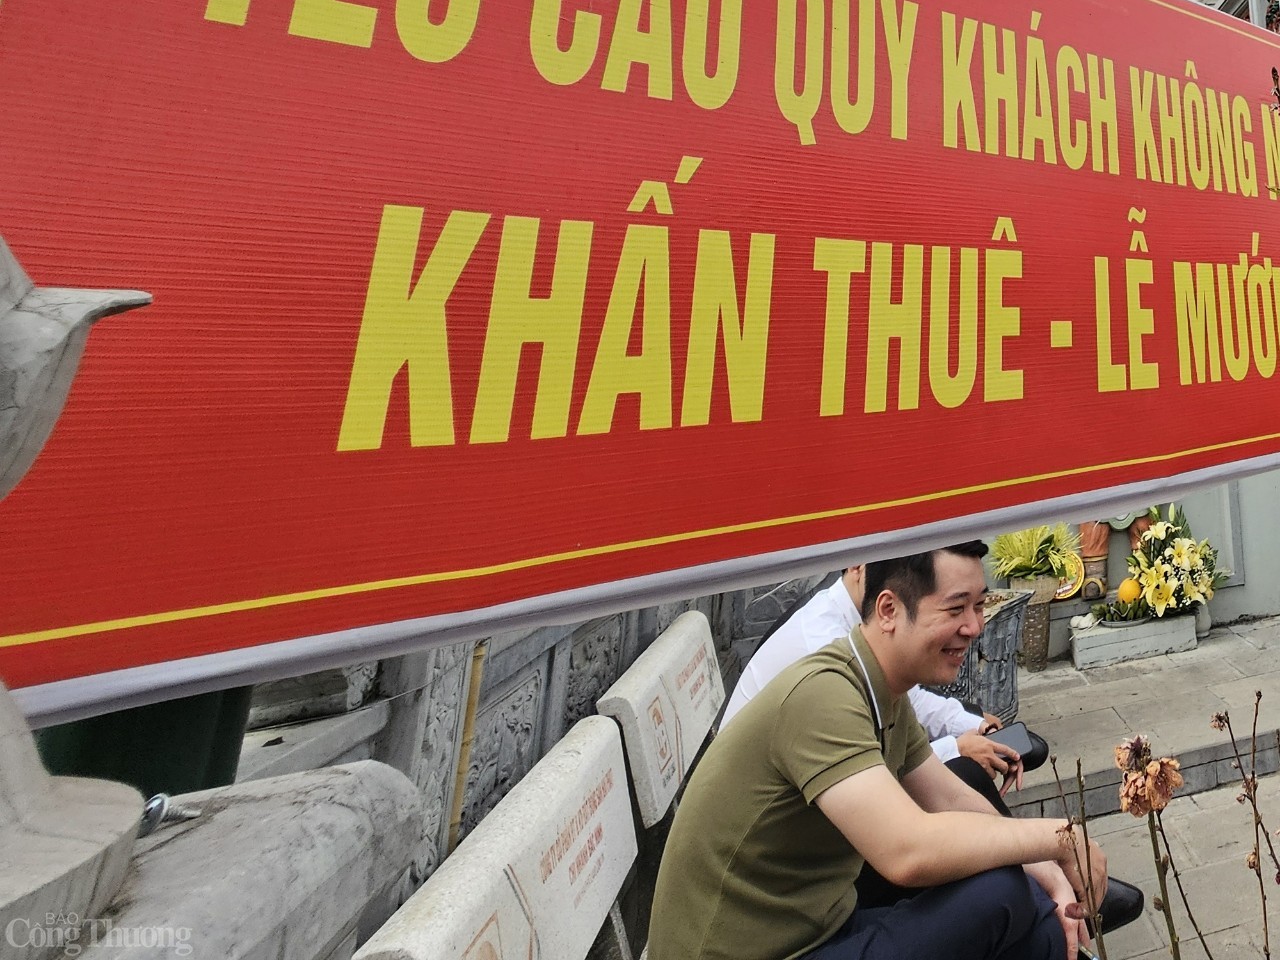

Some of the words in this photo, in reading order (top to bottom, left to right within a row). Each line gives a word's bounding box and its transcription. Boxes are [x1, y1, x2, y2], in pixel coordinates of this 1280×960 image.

[941, 10, 1120, 175] KHÁCH
[1129, 60, 1258, 197] KHÔNG
[336, 156, 775, 451] KHẤN
[813, 216, 1024, 417] THUÊ
[1050, 321, 1074, 348] -
[1095, 206, 1159, 392] LỄ
